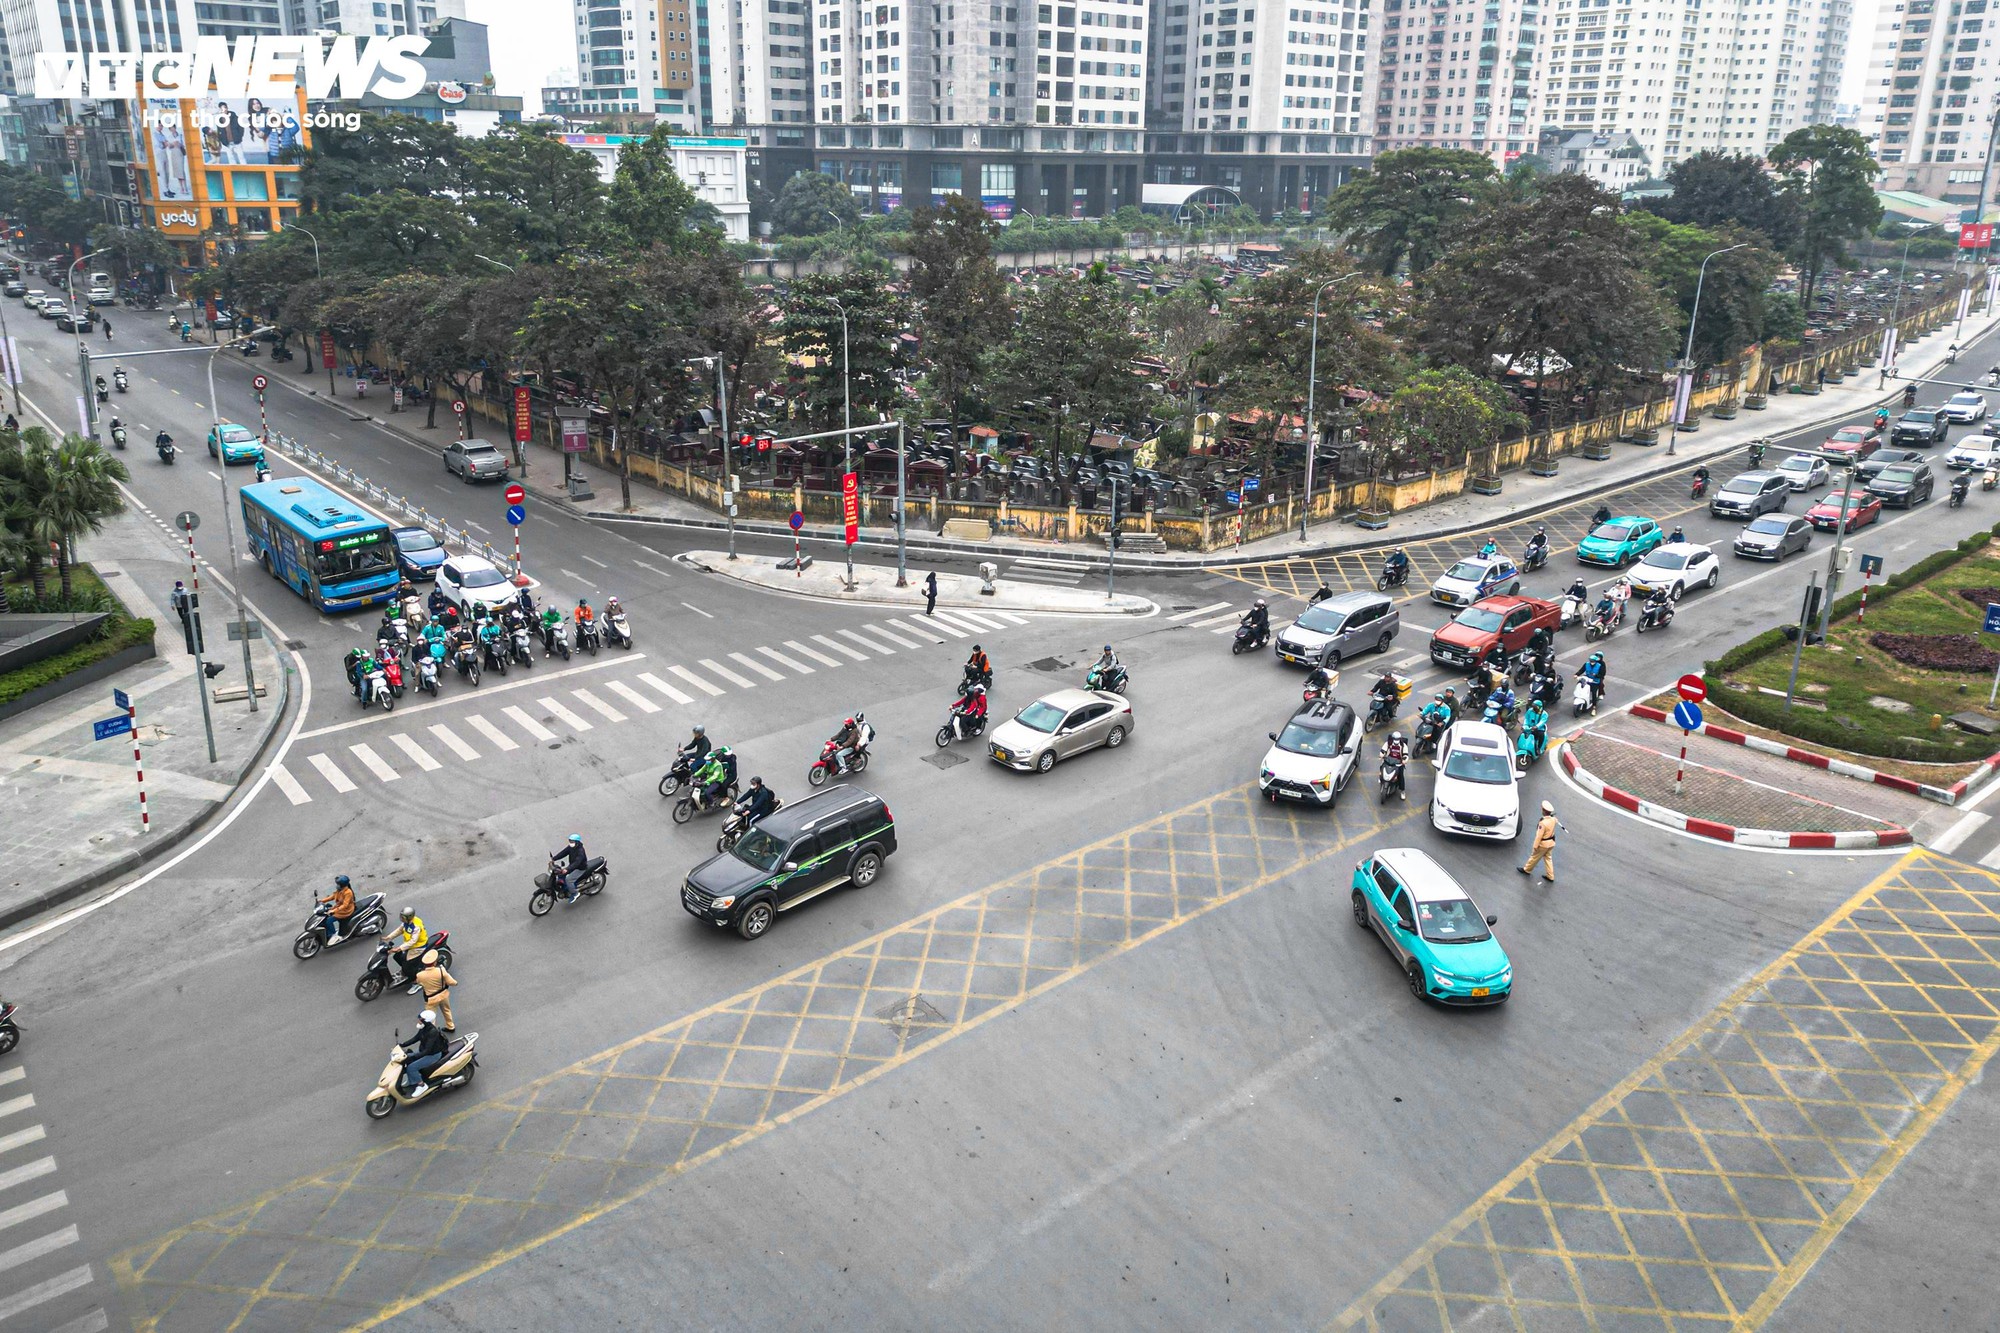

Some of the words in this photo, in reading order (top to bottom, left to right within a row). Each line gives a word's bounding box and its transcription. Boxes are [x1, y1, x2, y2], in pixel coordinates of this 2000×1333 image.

[971, 133, 978, 146] A
[161, 211, 197, 228] yody
[758, 440, 769, 450] 84
